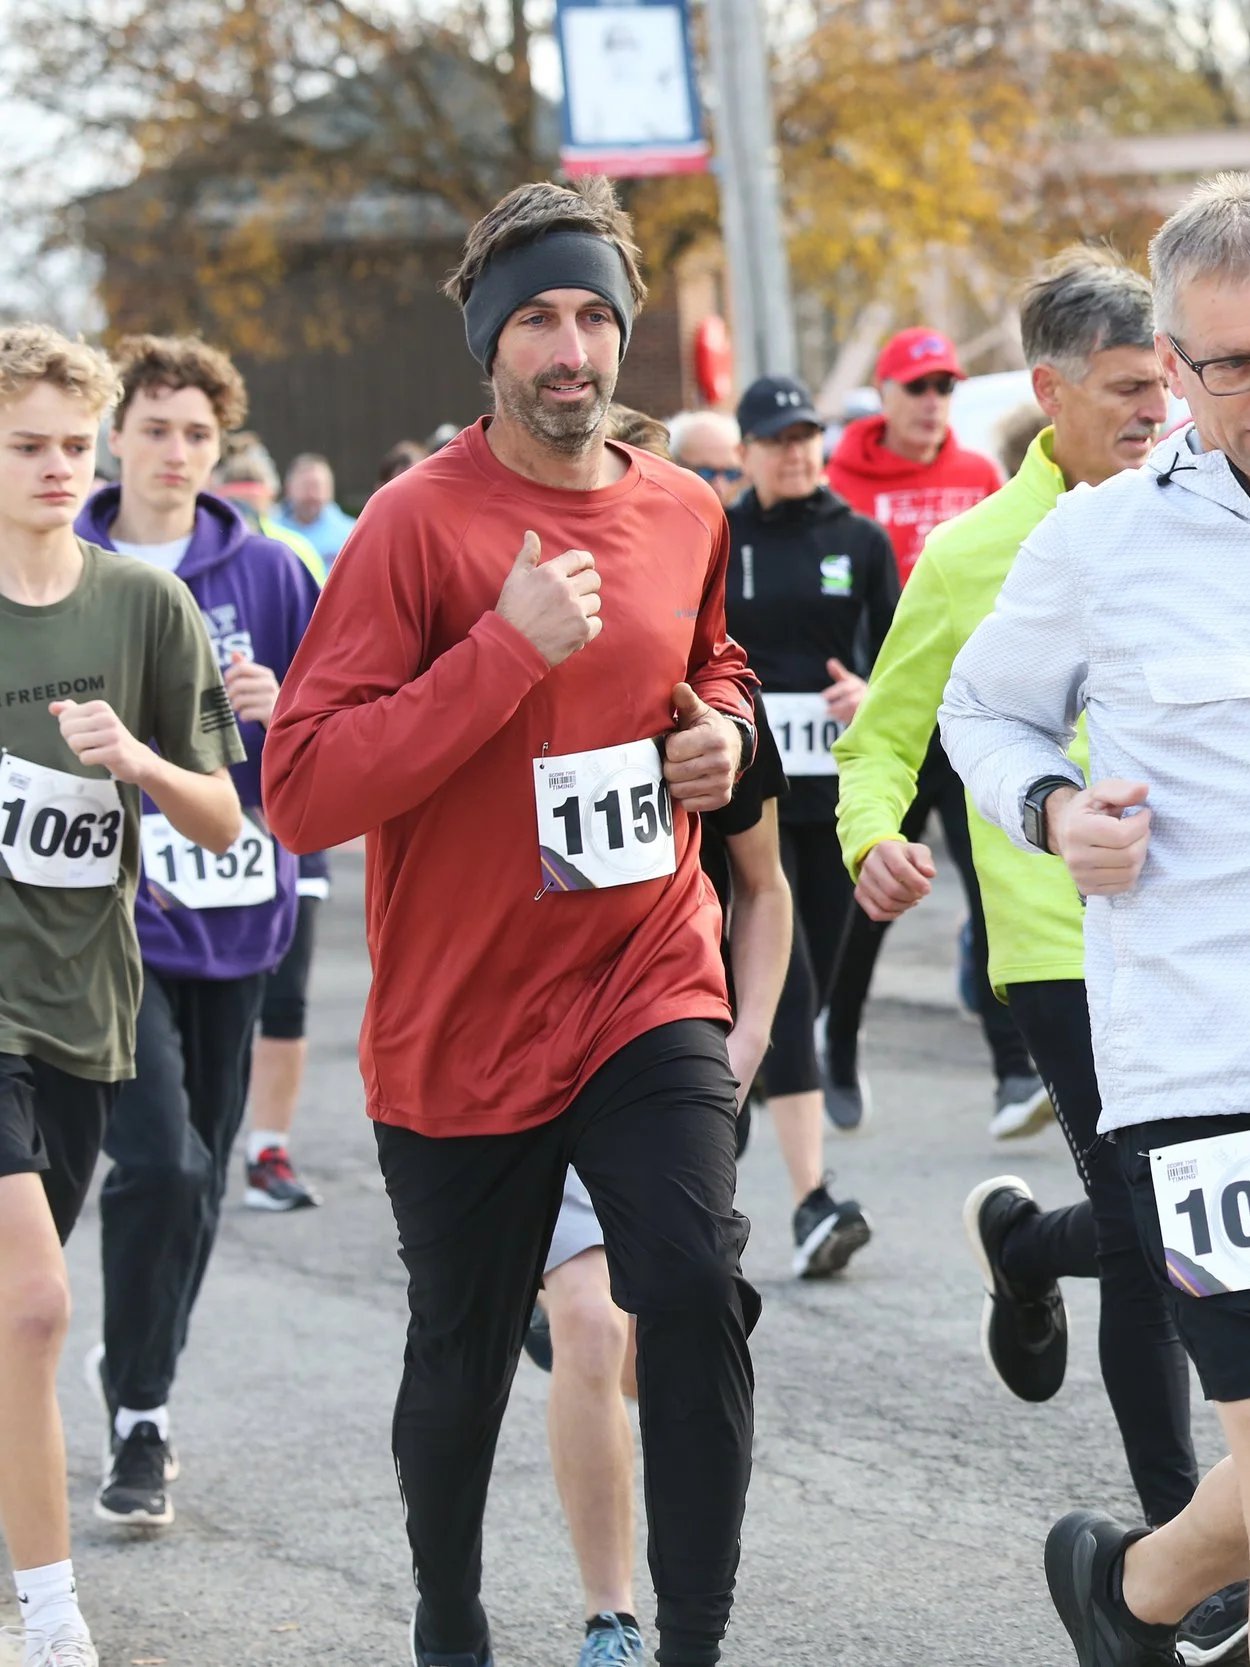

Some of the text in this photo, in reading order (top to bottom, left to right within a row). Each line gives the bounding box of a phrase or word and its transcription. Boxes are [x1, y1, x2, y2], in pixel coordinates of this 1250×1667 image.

[6, 676, 105, 707] FREEDOM
[777, 721, 839, 753] 110
[2, 798, 120, 859] 1063
[157, 838, 263, 883] 1152
